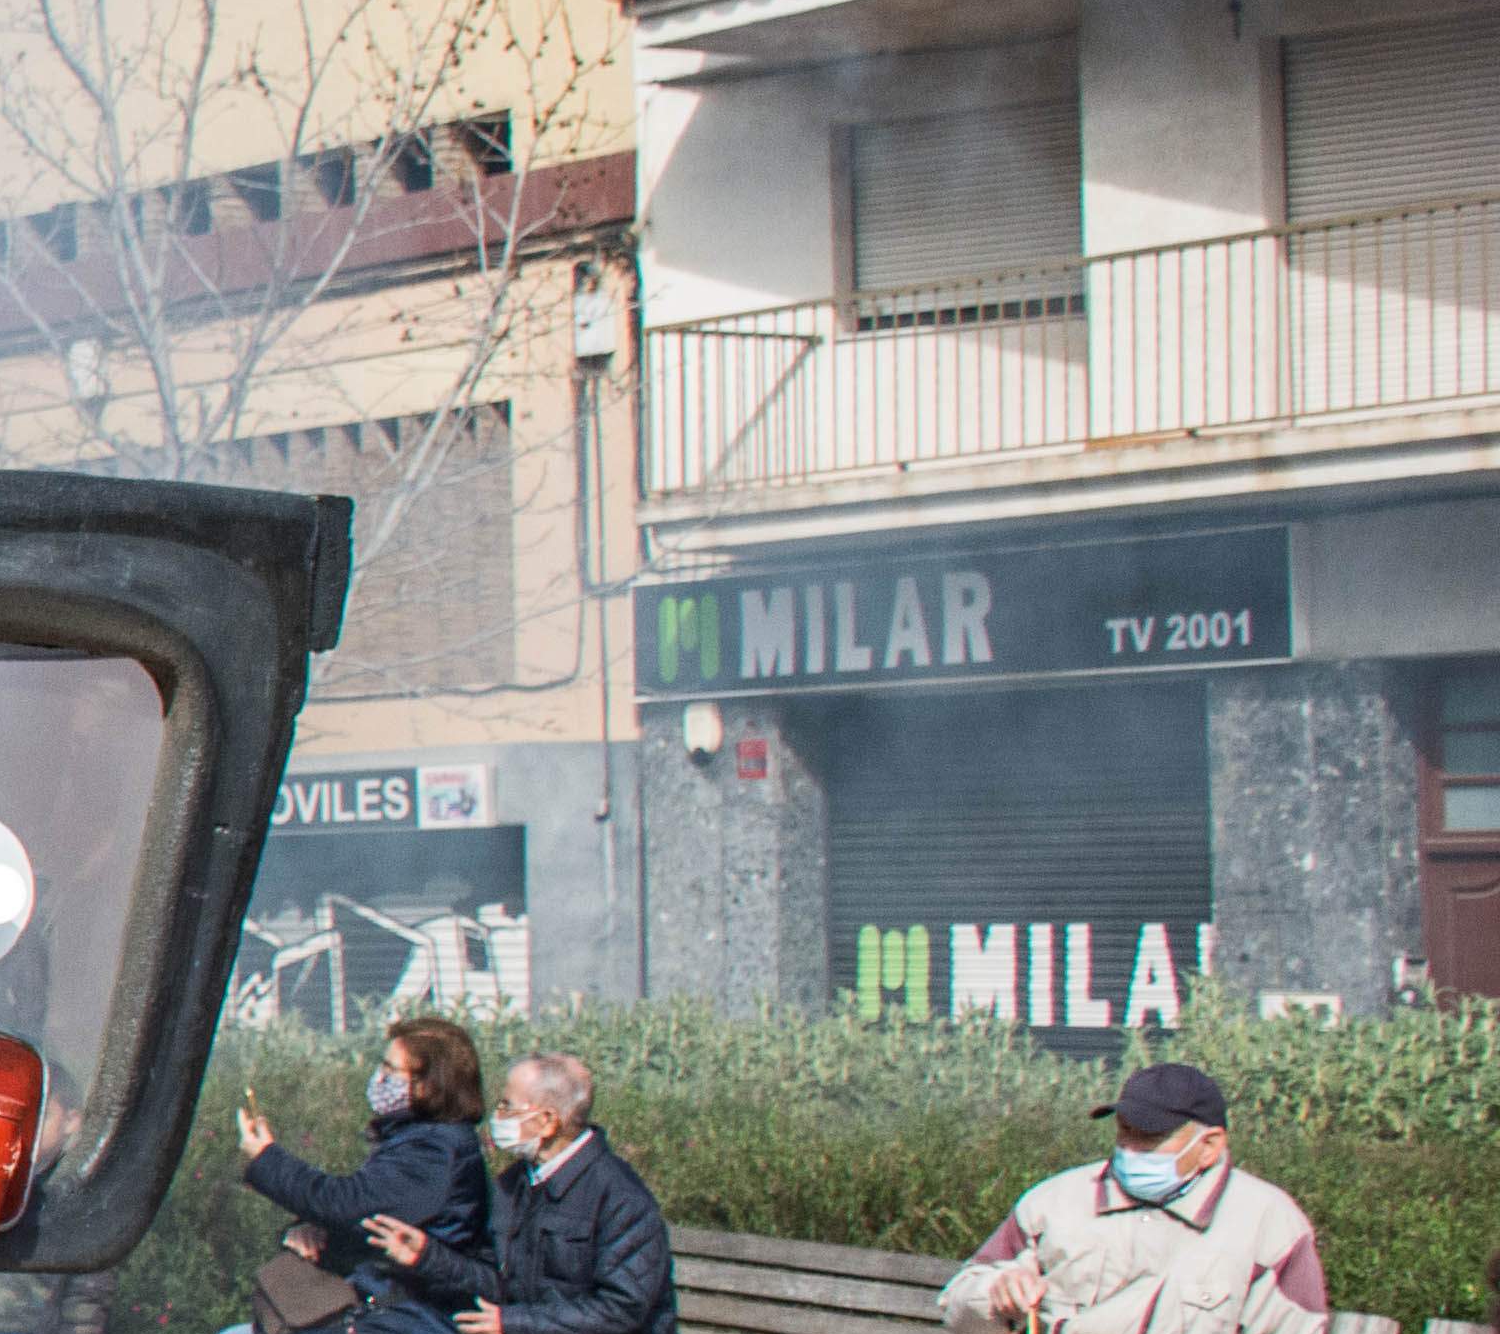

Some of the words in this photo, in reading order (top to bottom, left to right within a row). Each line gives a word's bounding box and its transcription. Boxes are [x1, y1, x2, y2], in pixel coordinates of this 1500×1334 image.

[740, 570, 994, 679] MILAR
[1105, 617, 1156, 653] TV
[1164, 609, 1252, 651] 2001
[950, 922, 1212, 1027] MILA
